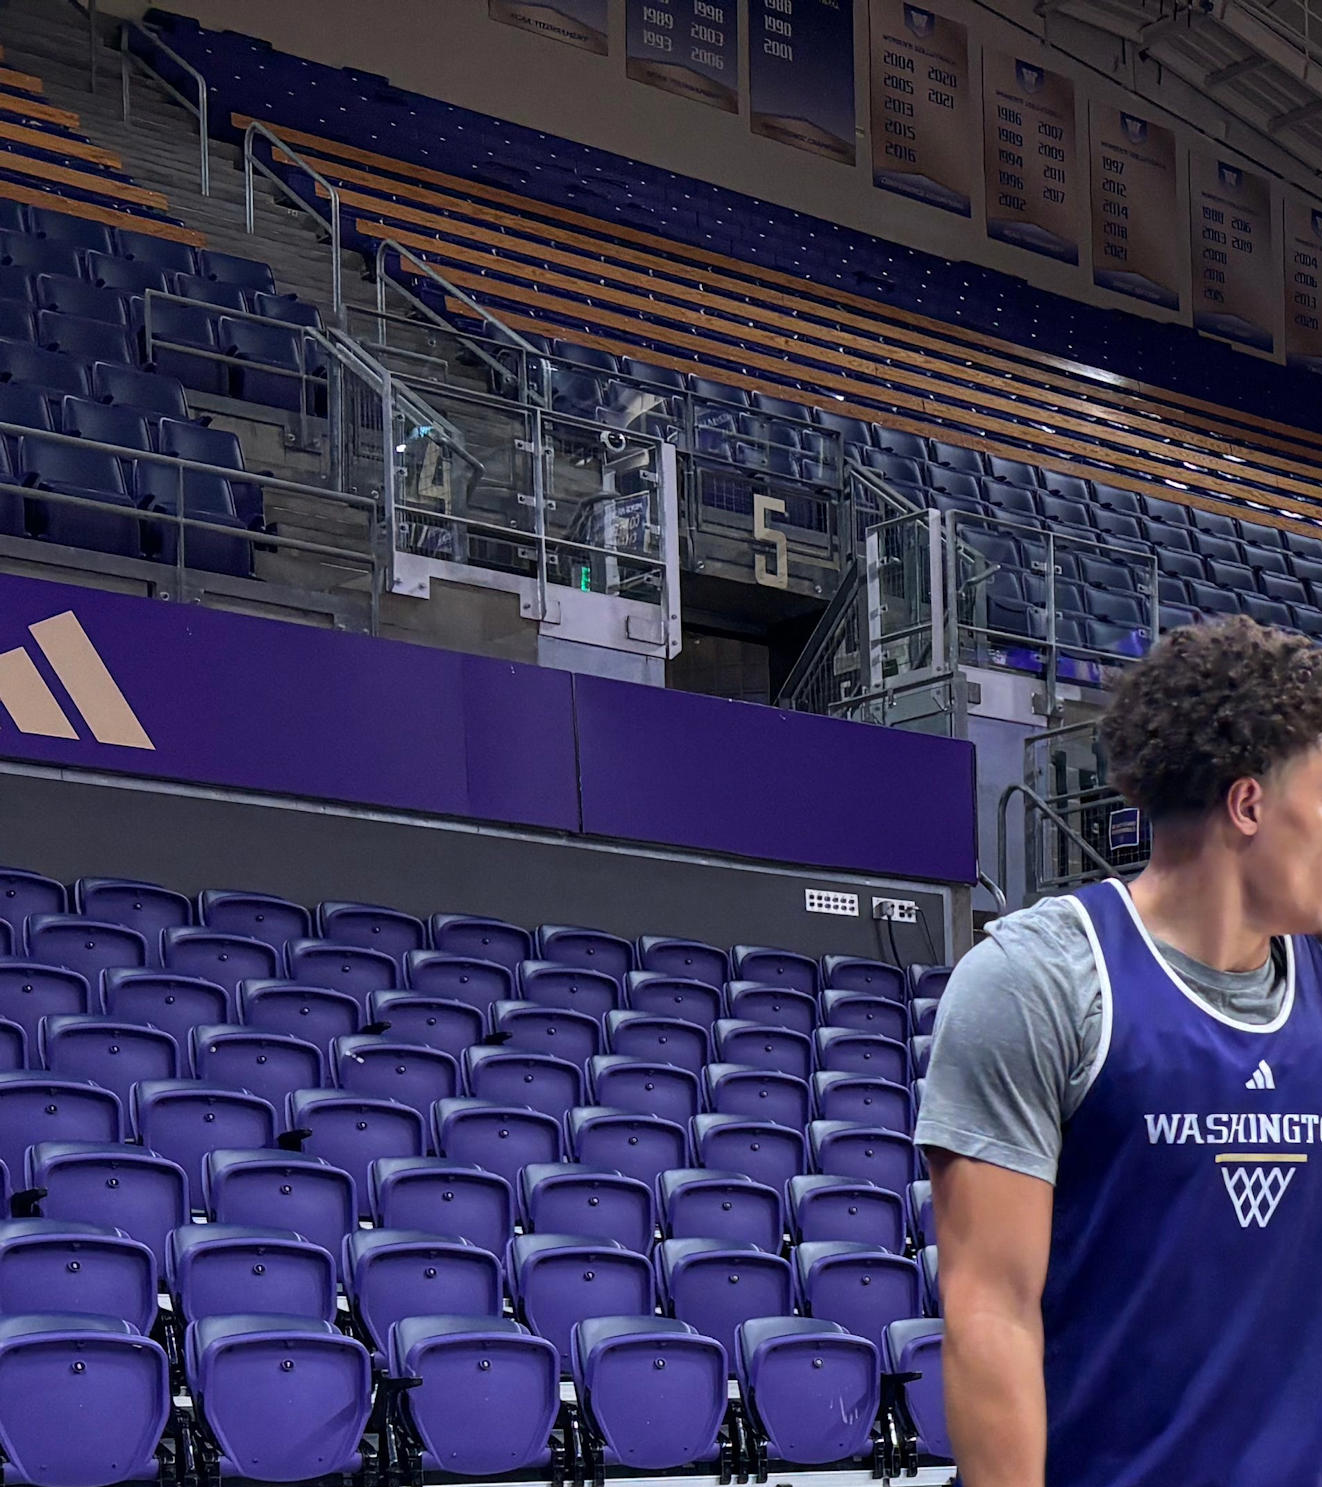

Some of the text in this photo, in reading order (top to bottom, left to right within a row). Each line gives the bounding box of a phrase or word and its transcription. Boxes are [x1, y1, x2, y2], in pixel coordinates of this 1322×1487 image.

[643, 6, 673, 29] 1989
[764, 15, 793, 37] 1990
[643, 30, 672, 52] 1993
[690, 22, 723, 47] 2003
[690, 46, 723, 70] 2006
[763, 38, 793, 62] 2001
[883, 50, 914, 73] 2004
[883, 72, 914, 95] 2005
[927, 66, 957, 88] 2020
[884, 95, 914, 117] 2013
[928, 88, 954, 109] 2021
[997, 105, 1022, 126] 1986
[884, 118, 915, 140] 2015
[997, 126, 1023, 147] 1989
[1038, 121, 1063, 141] 2007
[885, 142, 916, 163] 2016
[1038, 142, 1065, 162] 2009
[1043, 165, 1065, 184] 2011
[1102, 156, 1124, 175] 1997
[1043, 187, 1065, 204] 2017
[1102, 179, 1127, 198] 2012
[998, 192, 1026, 211] 2002
[1102, 199, 1128, 219] 2014
[753, 493, 788, 589] 5
